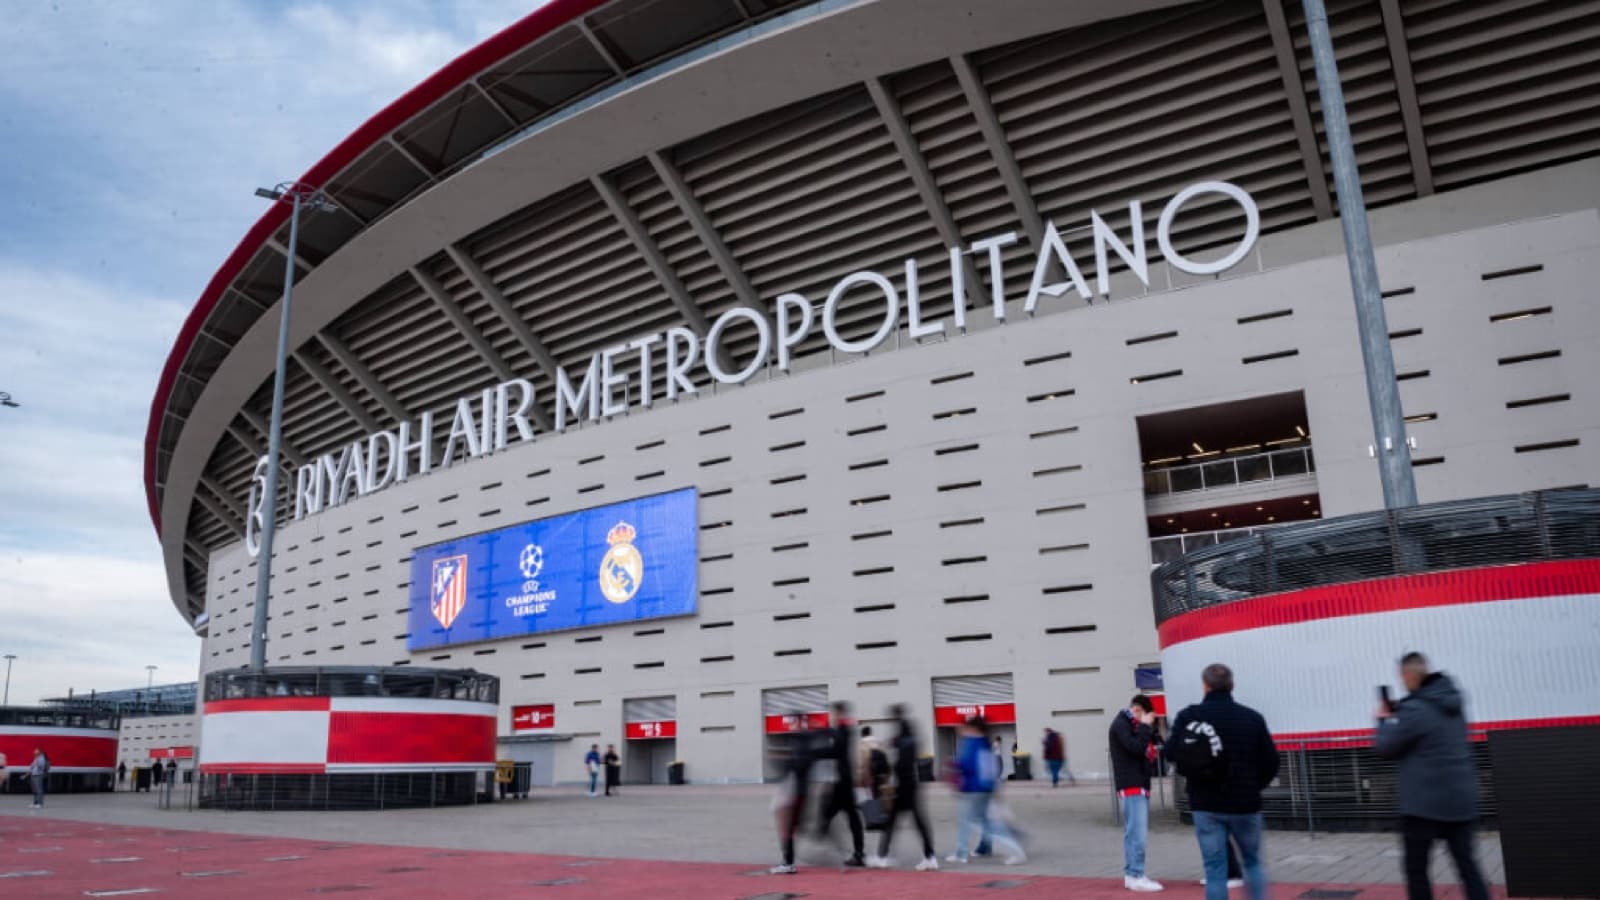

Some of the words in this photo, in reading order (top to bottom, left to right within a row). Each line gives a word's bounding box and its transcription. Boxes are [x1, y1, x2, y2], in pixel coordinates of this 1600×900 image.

[294, 411, 432, 520] RIYADH
[443, 377, 536, 468] AIR
[556, 180, 1260, 433] METROPOLITANO
[506, 589, 556, 608] CHAMPIONS
[513, 602, 548, 617] LEAGUE
